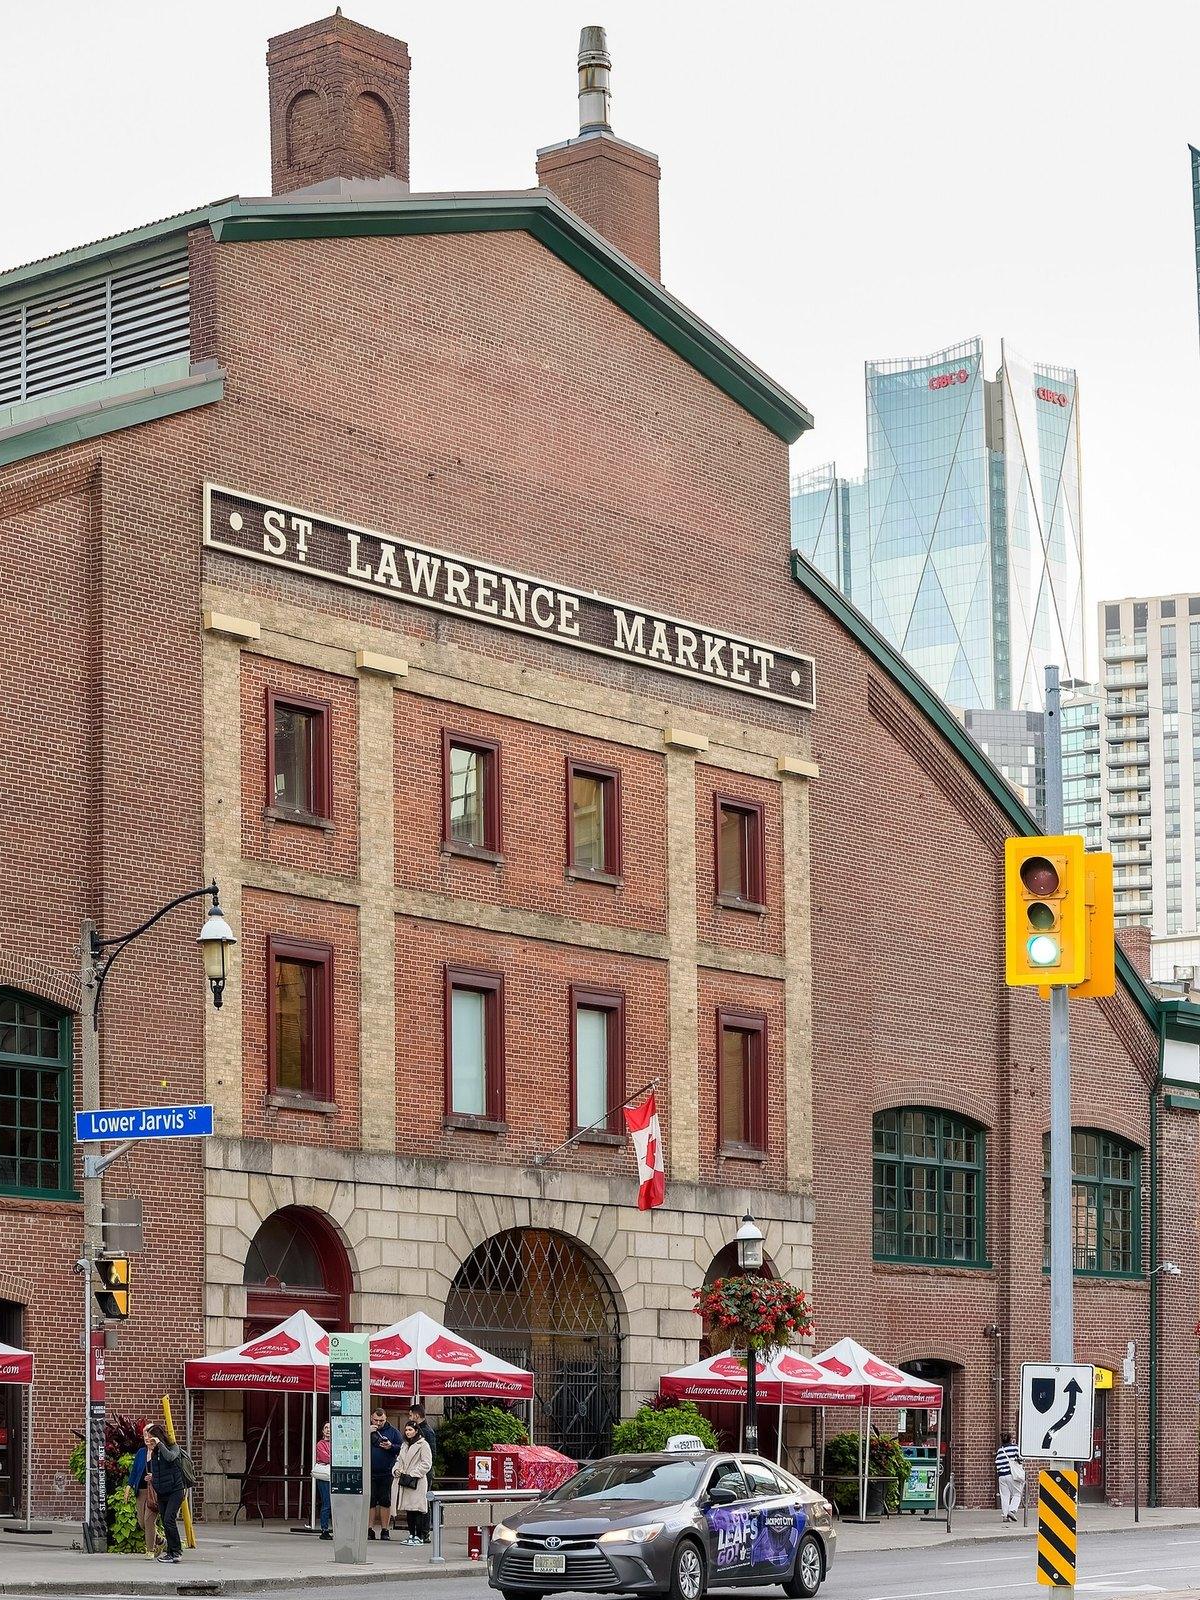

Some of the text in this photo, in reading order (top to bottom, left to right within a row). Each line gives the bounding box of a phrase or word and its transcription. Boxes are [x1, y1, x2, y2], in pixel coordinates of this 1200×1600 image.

[264, 511, 774, 689] ST LAWRENCE MARKET
[91, 1109, 197, 1133] Lower Jarvis St
[211, 1370, 299, 1384] stlawrencemarket.com
[444, 1377, 522, 1391] stlawrencemarket.com
[98, 1470, 106, 1502] LAWRENCE
[765, 1517, 794, 1526] JACKPOT CITY
[718, 1517, 758, 1551] LEAFS
[718, 1543, 740, 1566] GO!
